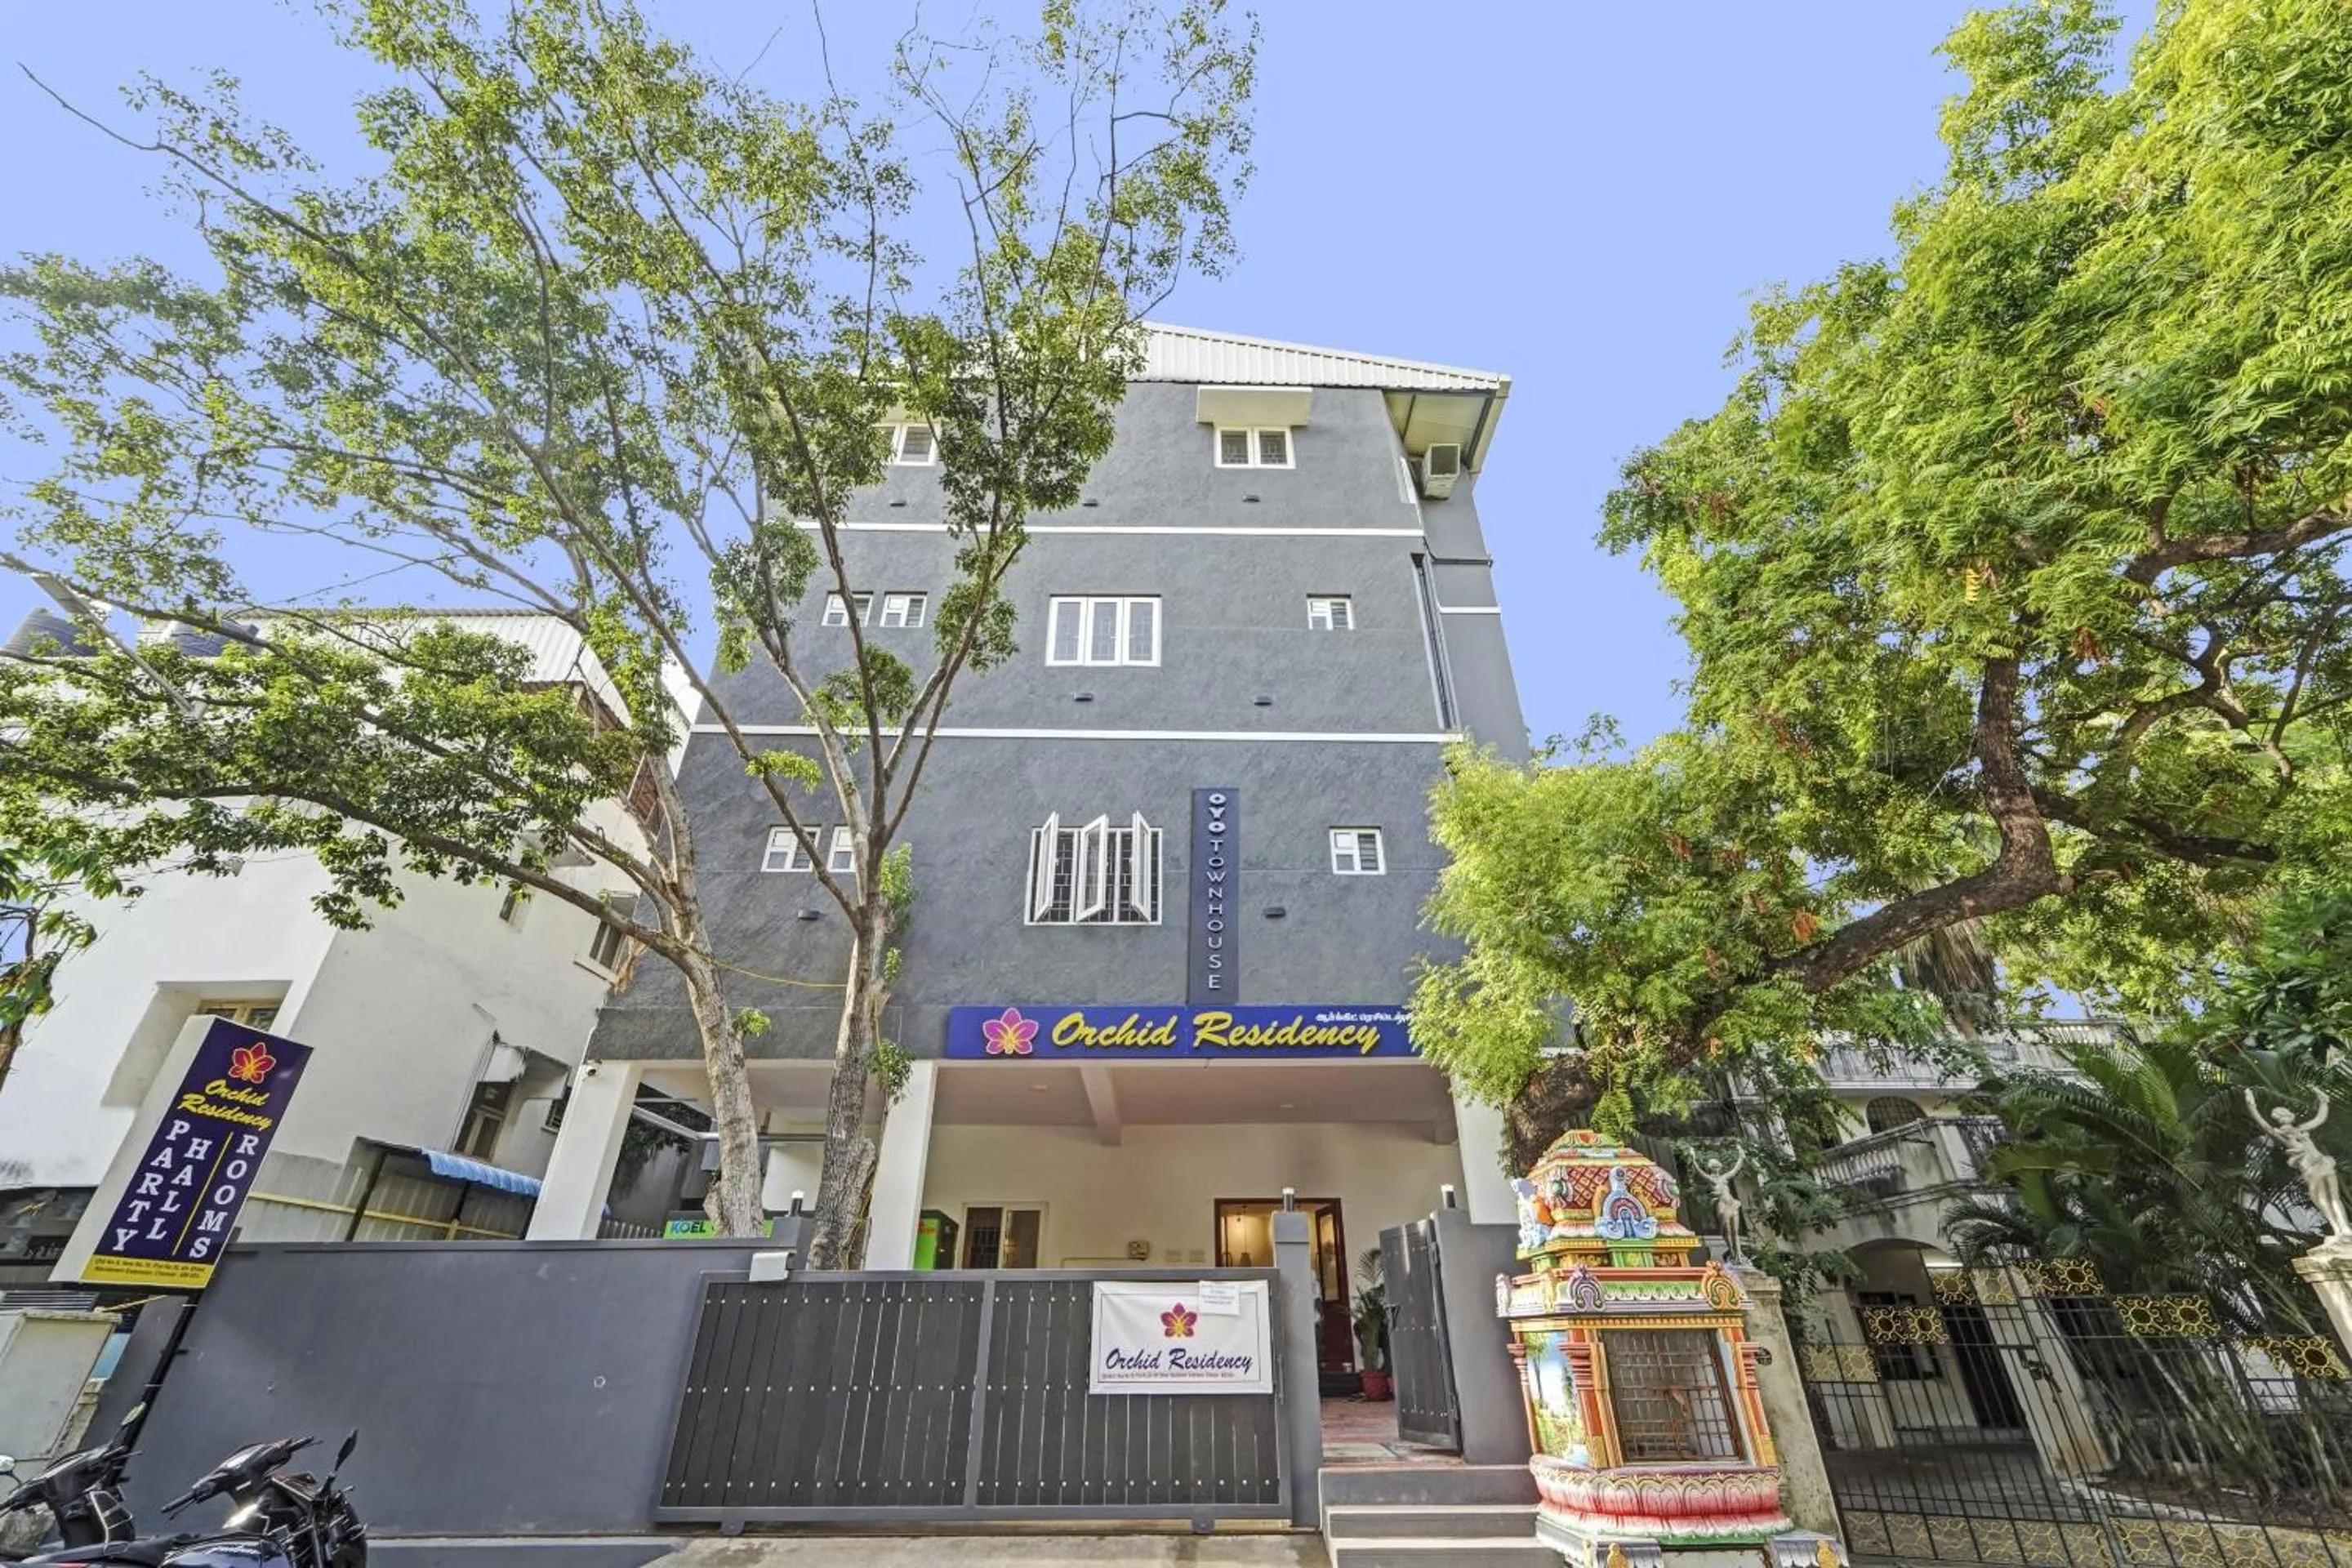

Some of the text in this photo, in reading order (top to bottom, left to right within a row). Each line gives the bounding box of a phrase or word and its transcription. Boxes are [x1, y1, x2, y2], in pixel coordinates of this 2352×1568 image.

[1209, 793, 1226, 833] OYO
[1051, 1011, 1380, 1054] Orchid Residency
[205, 1079, 270, 1106] Orchid
[177, 1094, 273, 1131] Residency
[113, 1119, 212, 1251] PARTY HALL
[189, 1134, 259, 1258] ROOMS
[670, 1220, 706, 1233] KOEL
[1106, 1348, 1253, 1374] Orchid Residency
